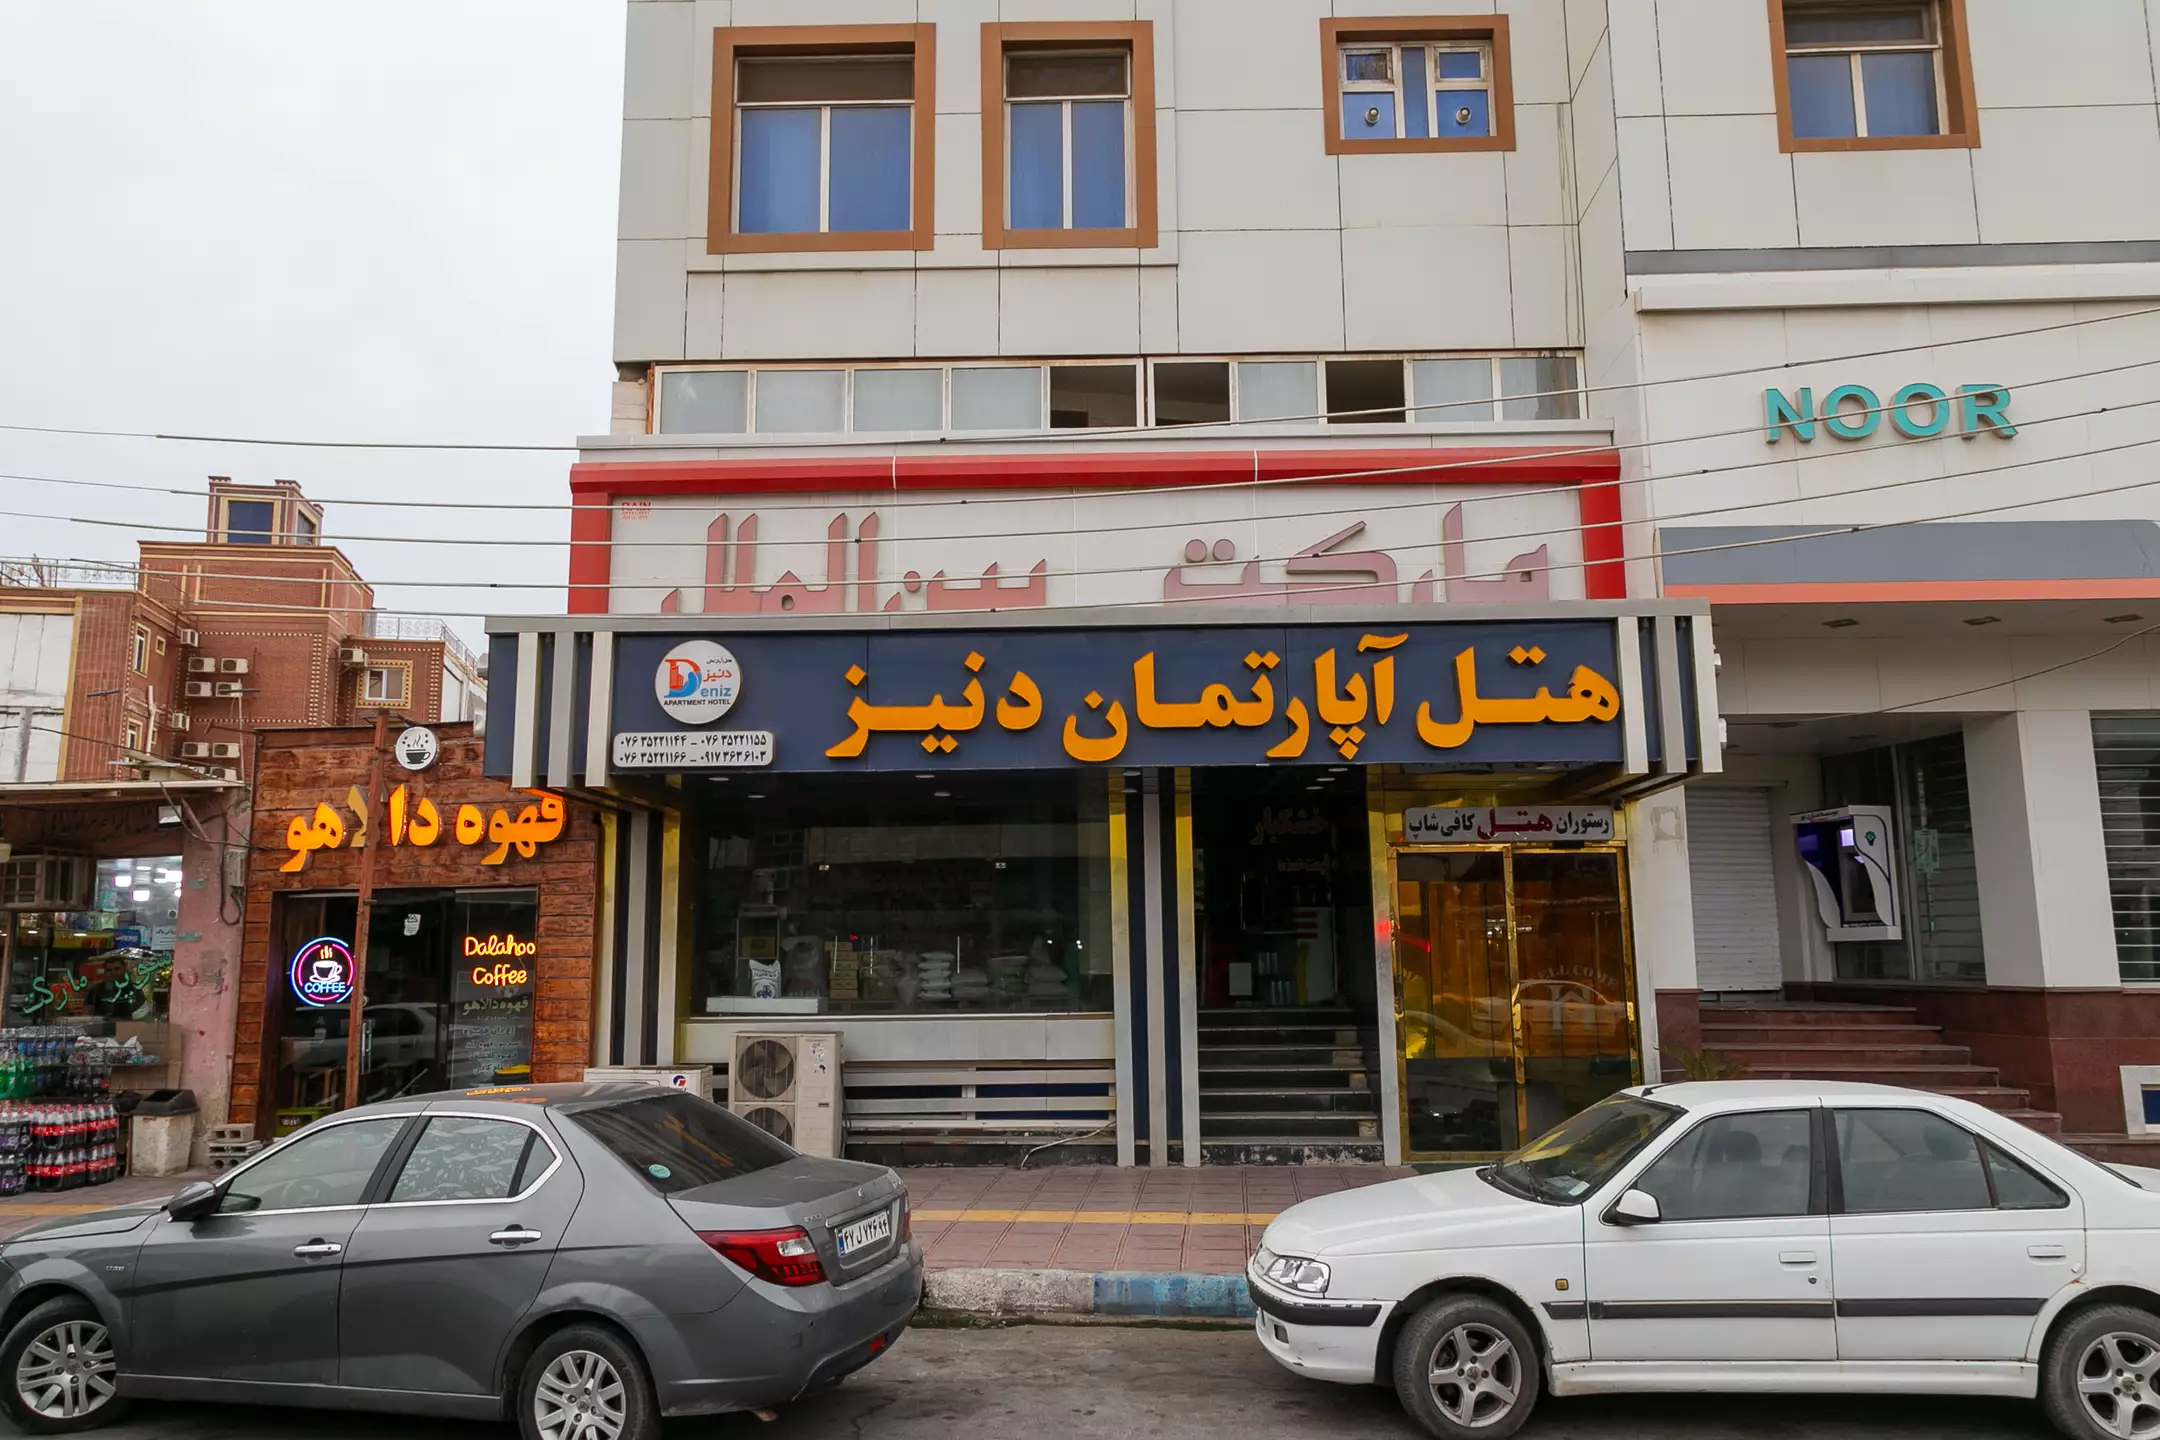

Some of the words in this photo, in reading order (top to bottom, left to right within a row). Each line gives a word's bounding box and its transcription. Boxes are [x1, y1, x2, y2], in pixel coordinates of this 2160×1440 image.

[1761, 383, 2019, 443] NOOR
[703, 668, 732, 682] دنیز
[825, 650, 1043, 759] دنیز
[1063, 633, 1409, 761] آپارتمان
[1416, 645, 1620, 749] هتل
[455, 790, 564, 865] قهوه
[1409, 813, 1440, 839] شاپ
[1441, 810, 1476, 836] کافی
[1477, 808, 1554, 840] هتل
[1556, 811, 1609, 835] رستوران
[465, 934, 536, 956] Dalahoo
[108, 950, 172, 1004] سوپر
[304, 981, 346, 993] COFFEE
[472, 964, 528, 986] Coffee
[22, 967, 87, 1014] مارکت
[462, 997, 499, 1015] دالاهو
[500, 996, 529, 1014] قهوه
